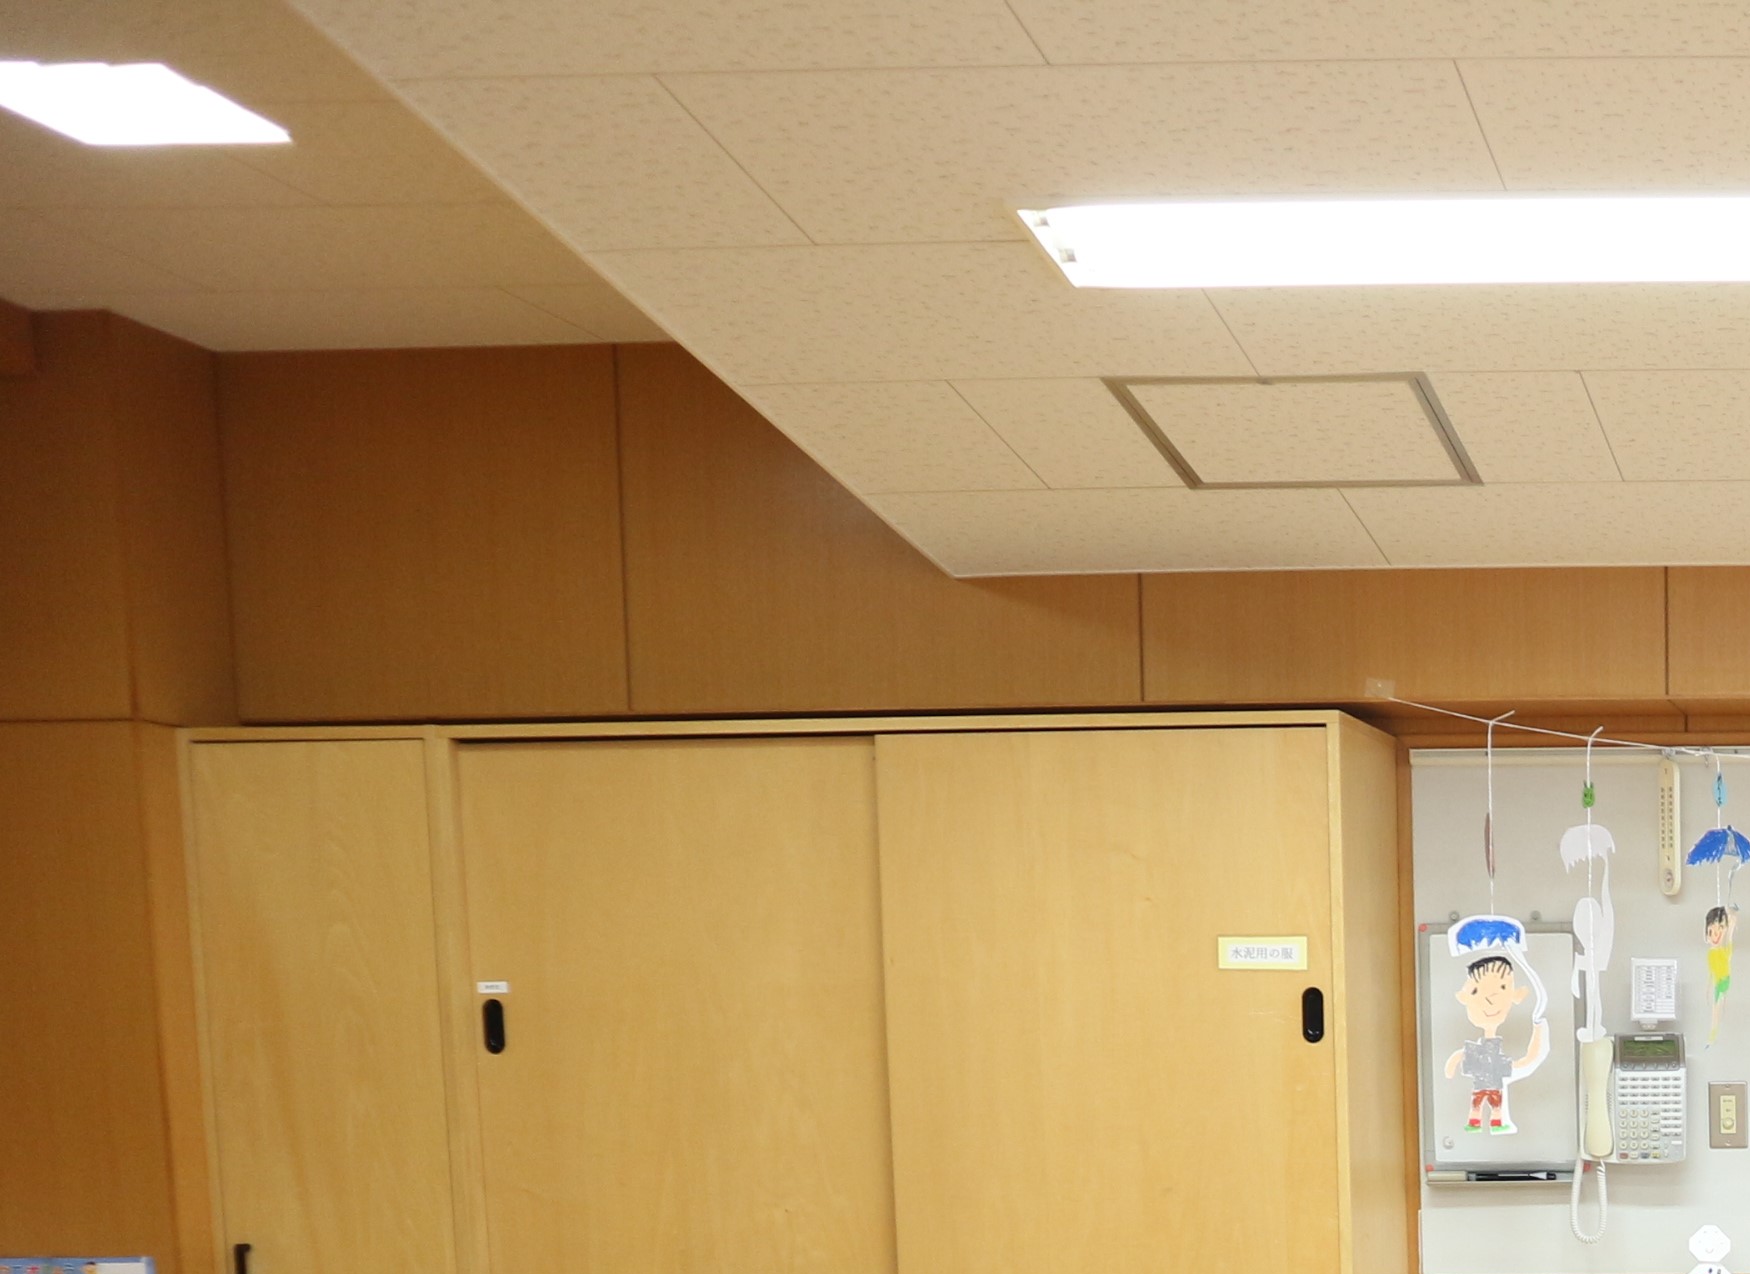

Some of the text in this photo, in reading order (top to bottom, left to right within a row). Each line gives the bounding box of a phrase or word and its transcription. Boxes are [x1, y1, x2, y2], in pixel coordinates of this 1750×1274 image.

[1231, 947, 1293, 960] 水泥用の服
